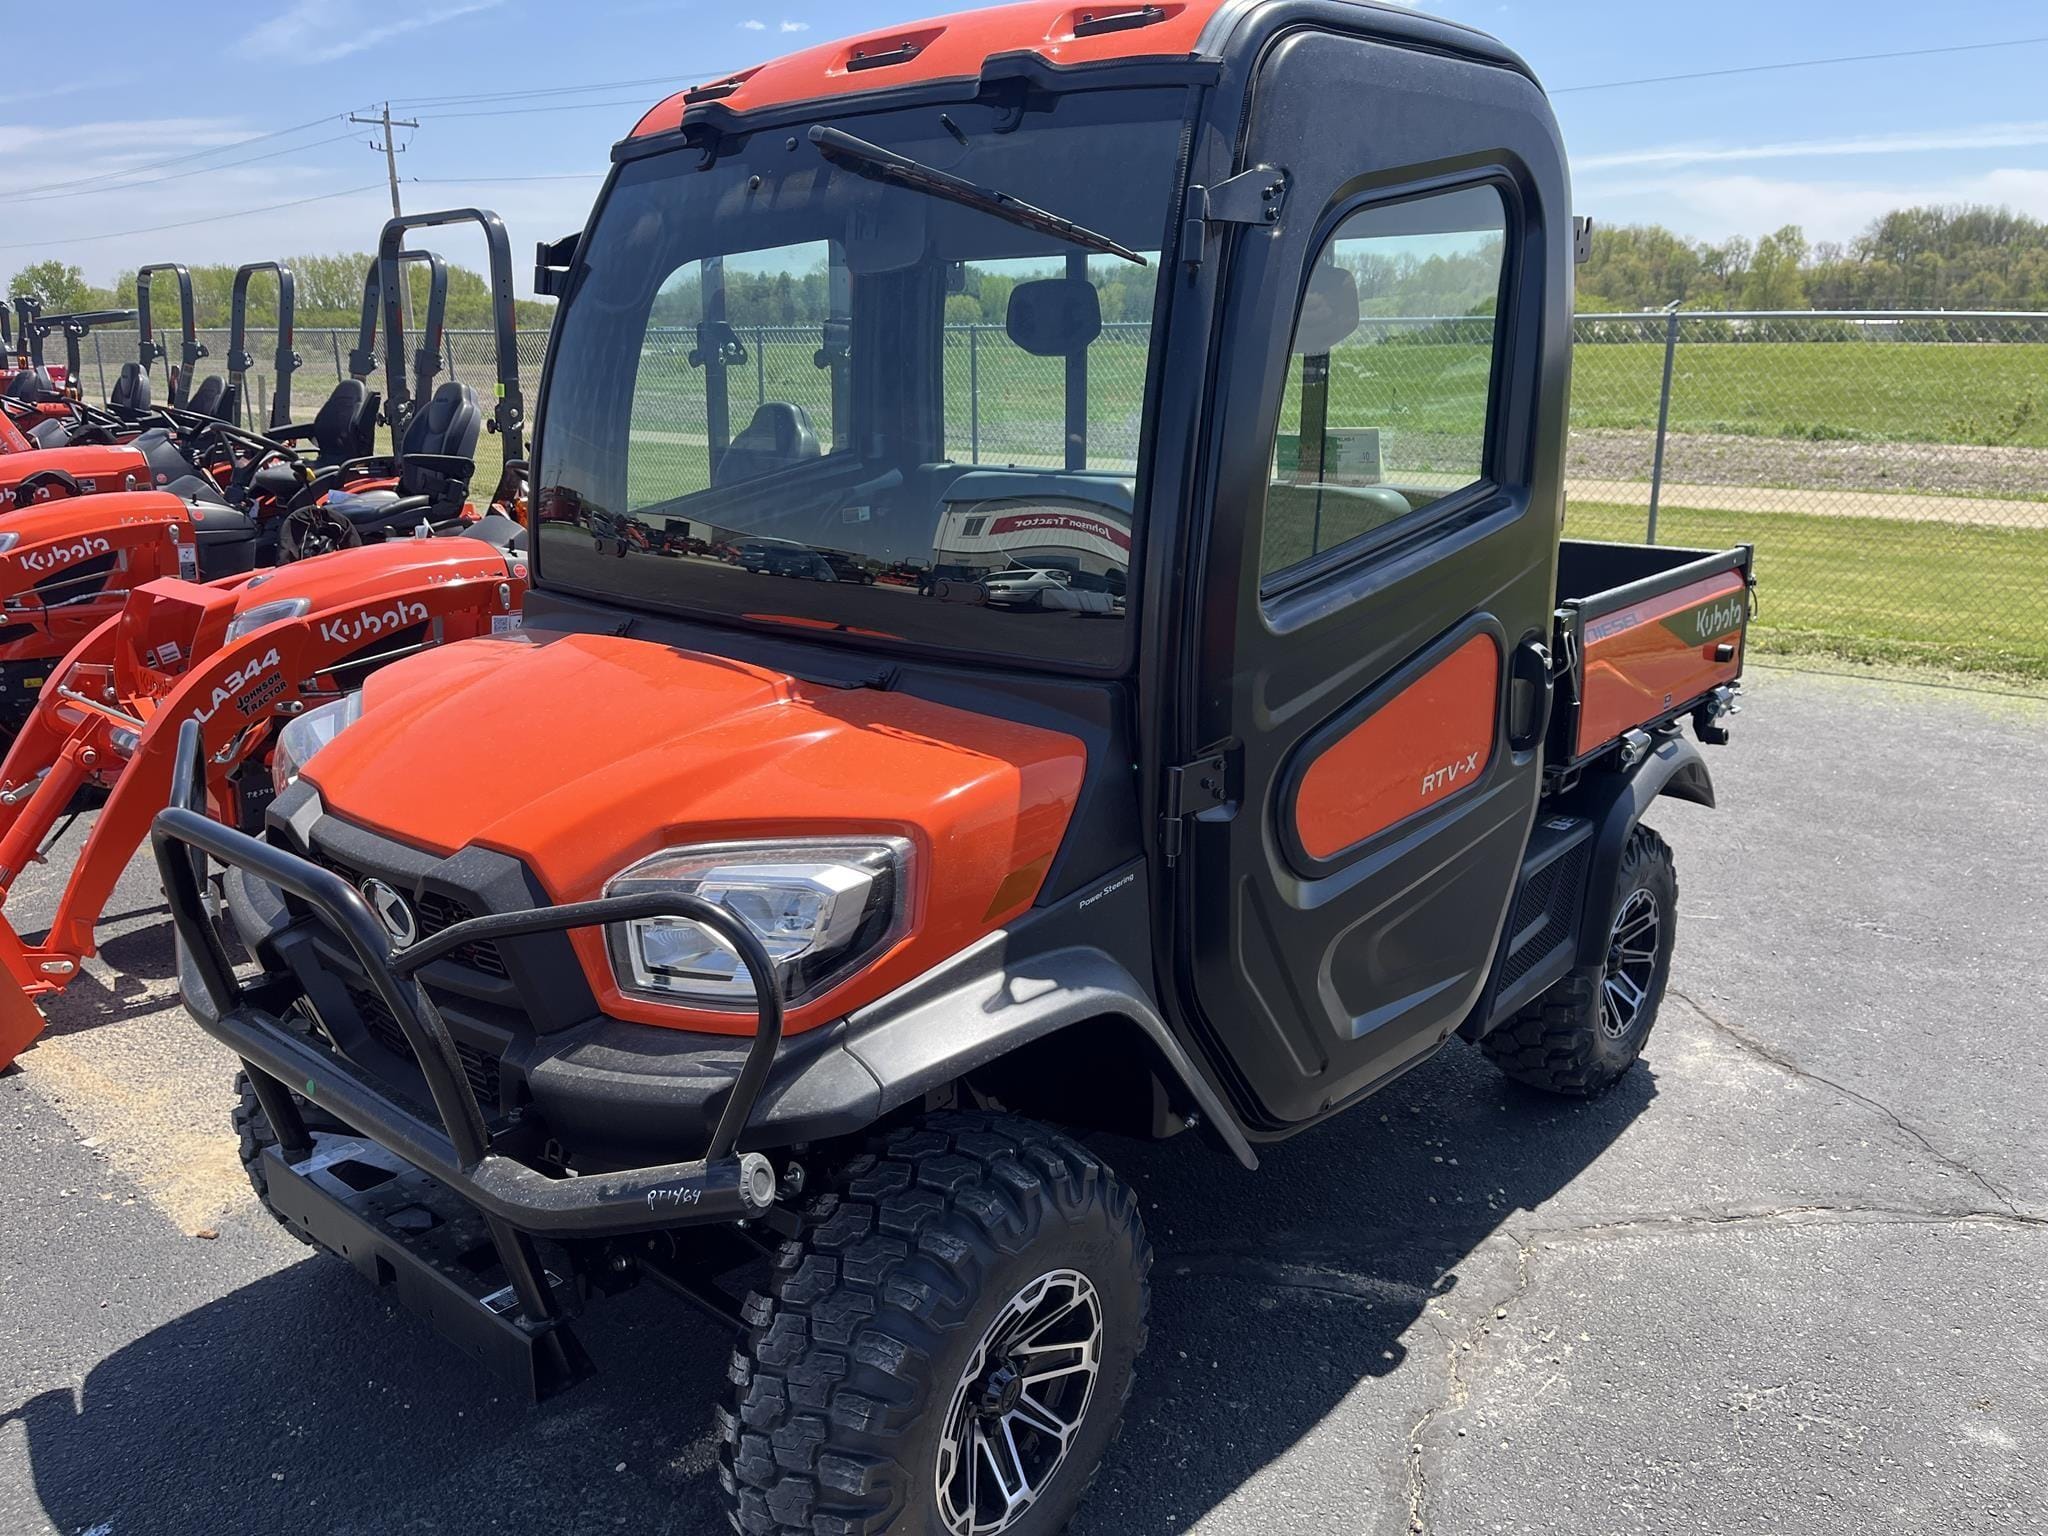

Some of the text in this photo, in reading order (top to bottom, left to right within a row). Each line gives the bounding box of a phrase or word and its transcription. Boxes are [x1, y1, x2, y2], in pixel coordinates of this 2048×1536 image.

[20, 537, 110, 570] Kubota
[320, 601, 429, 643] Kubota
[1587, 613, 1641, 642] DIESEL
[1696, 598, 1742, 637] Kubota
[193, 647, 281, 724] LA344
[236, 671, 281, 709] JOHNSON
[241, 681, 288, 718] TRACTOR
[1421, 751, 1478, 796] RTV-X
[1080, 873, 1134, 909] Power Steering
